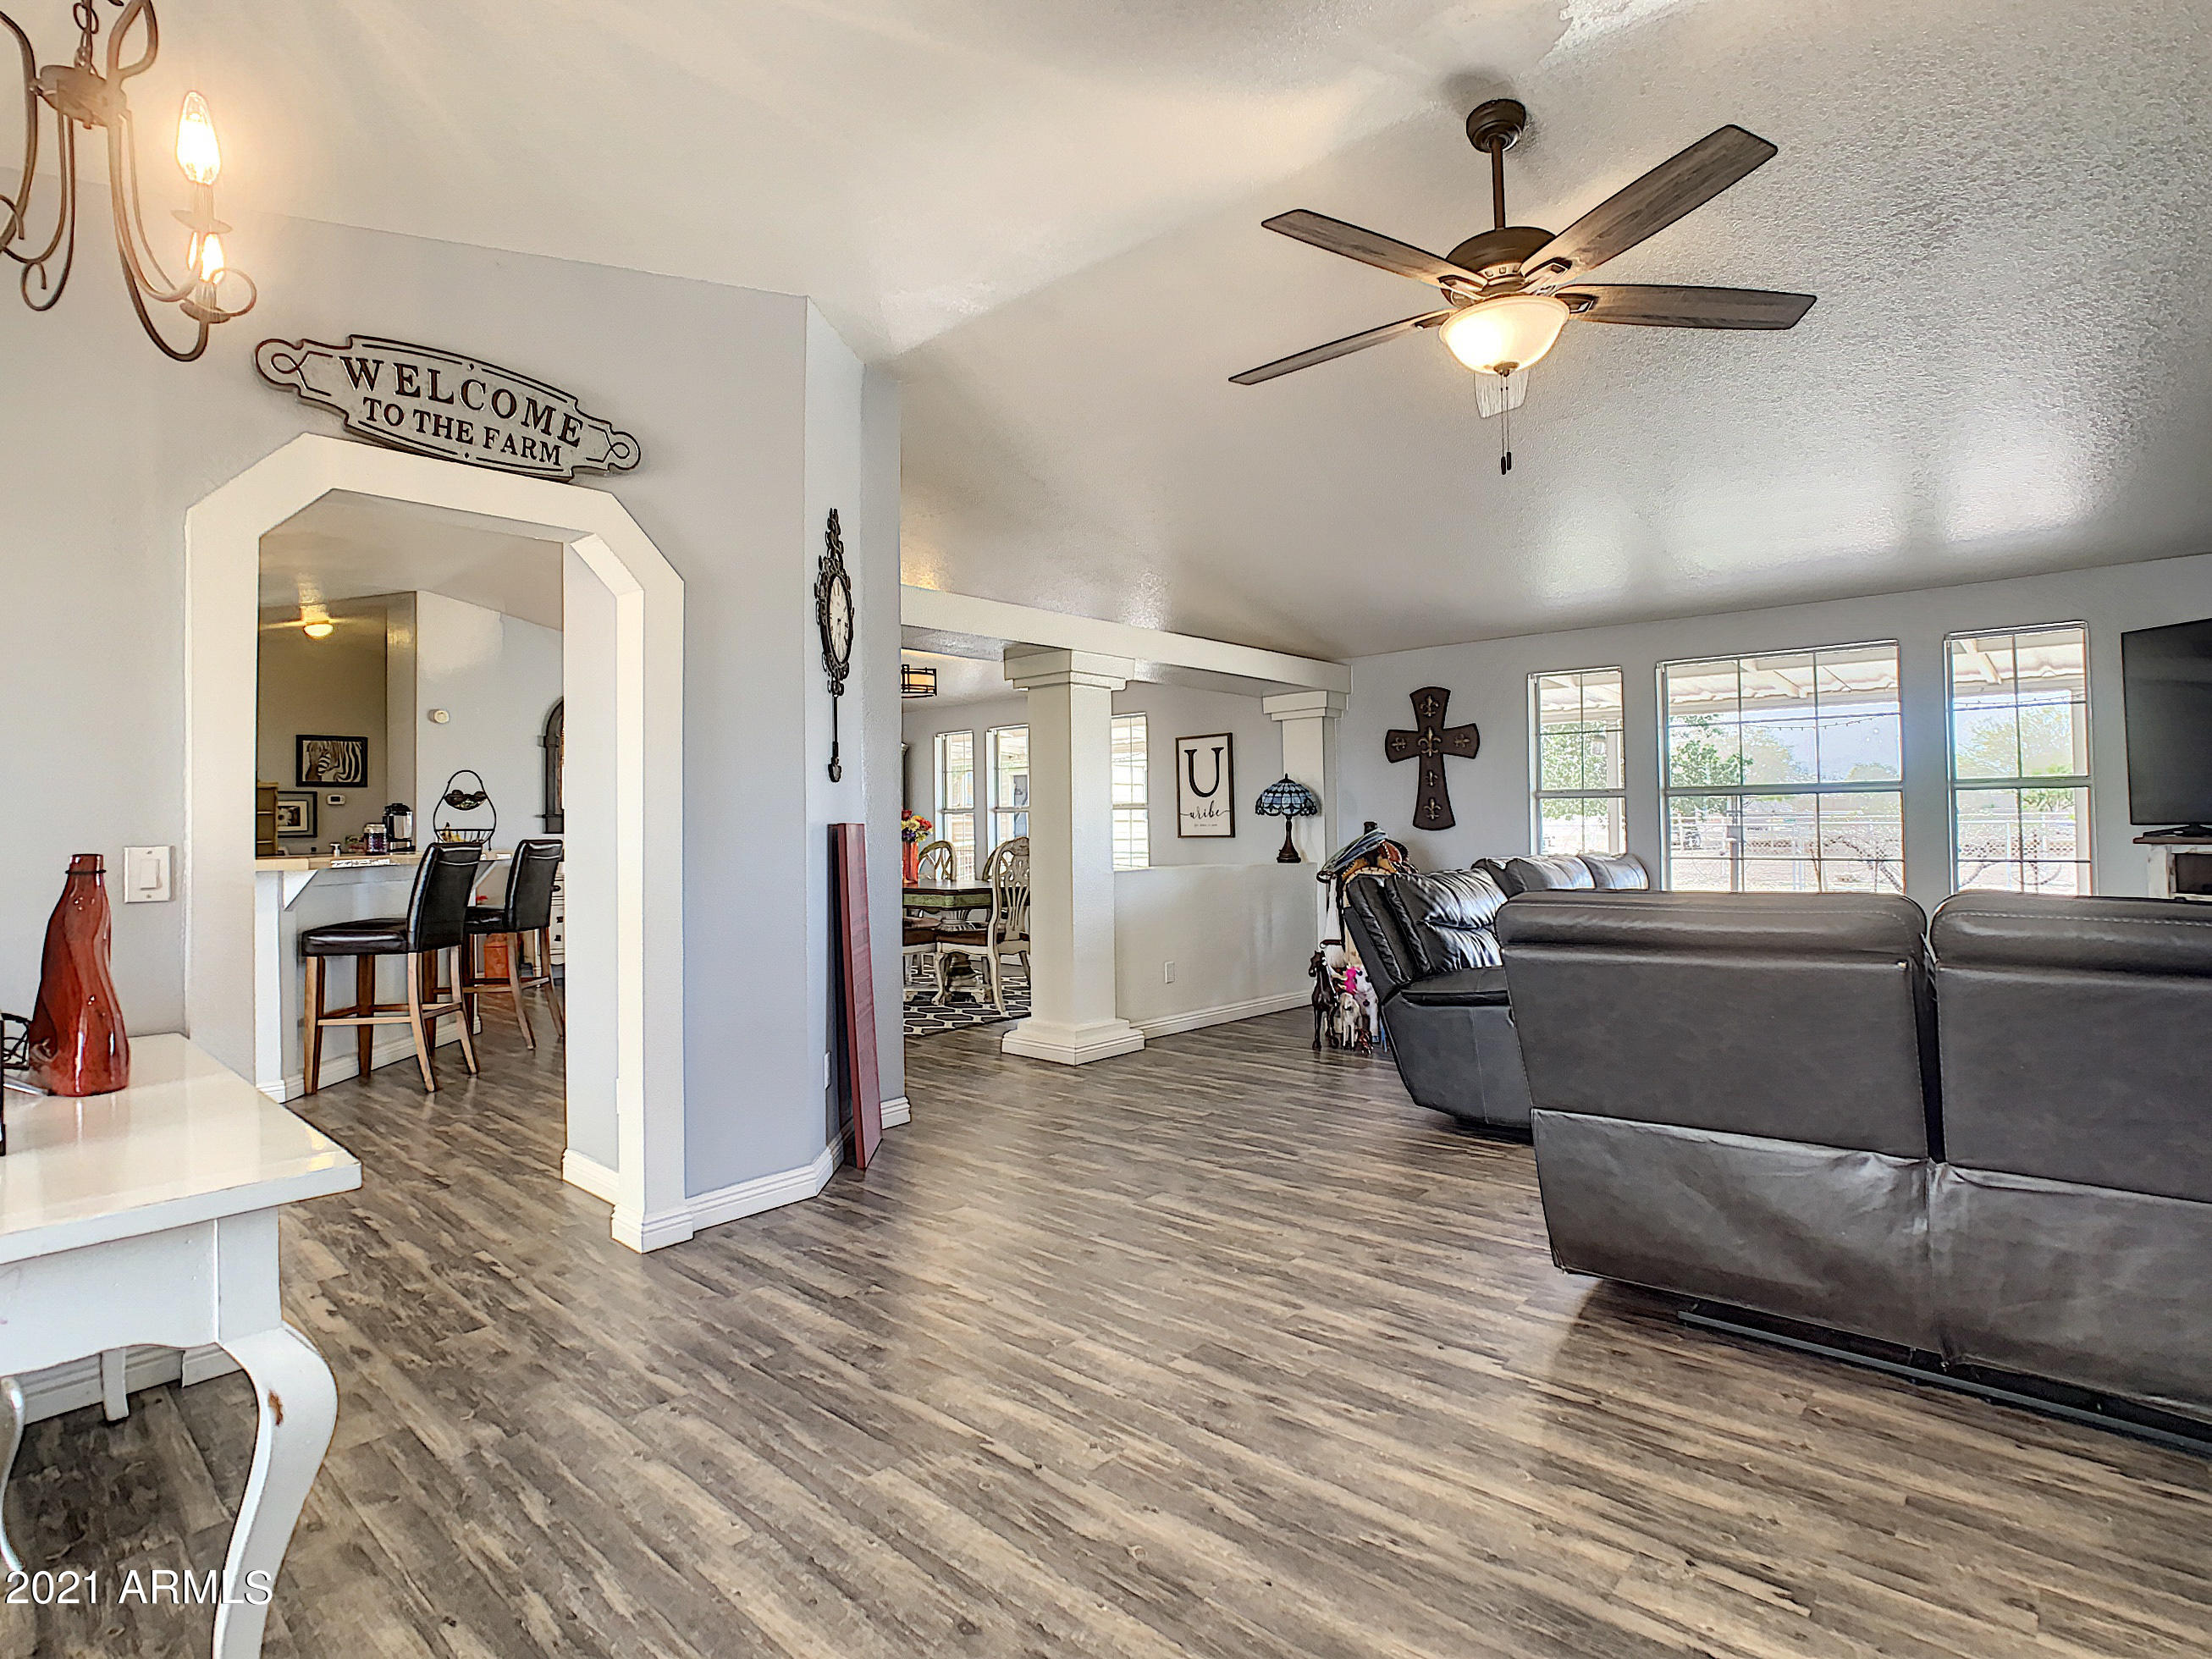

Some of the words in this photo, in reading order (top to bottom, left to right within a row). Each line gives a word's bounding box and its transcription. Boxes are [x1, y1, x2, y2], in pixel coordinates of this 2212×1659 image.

[340, 356, 584, 448] WELCOME
[362, 396, 405, 427] TO
[411, 408, 475, 444] THE
[483, 426, 563, 466] FARM
[1183, 747, 1224, 797] U
